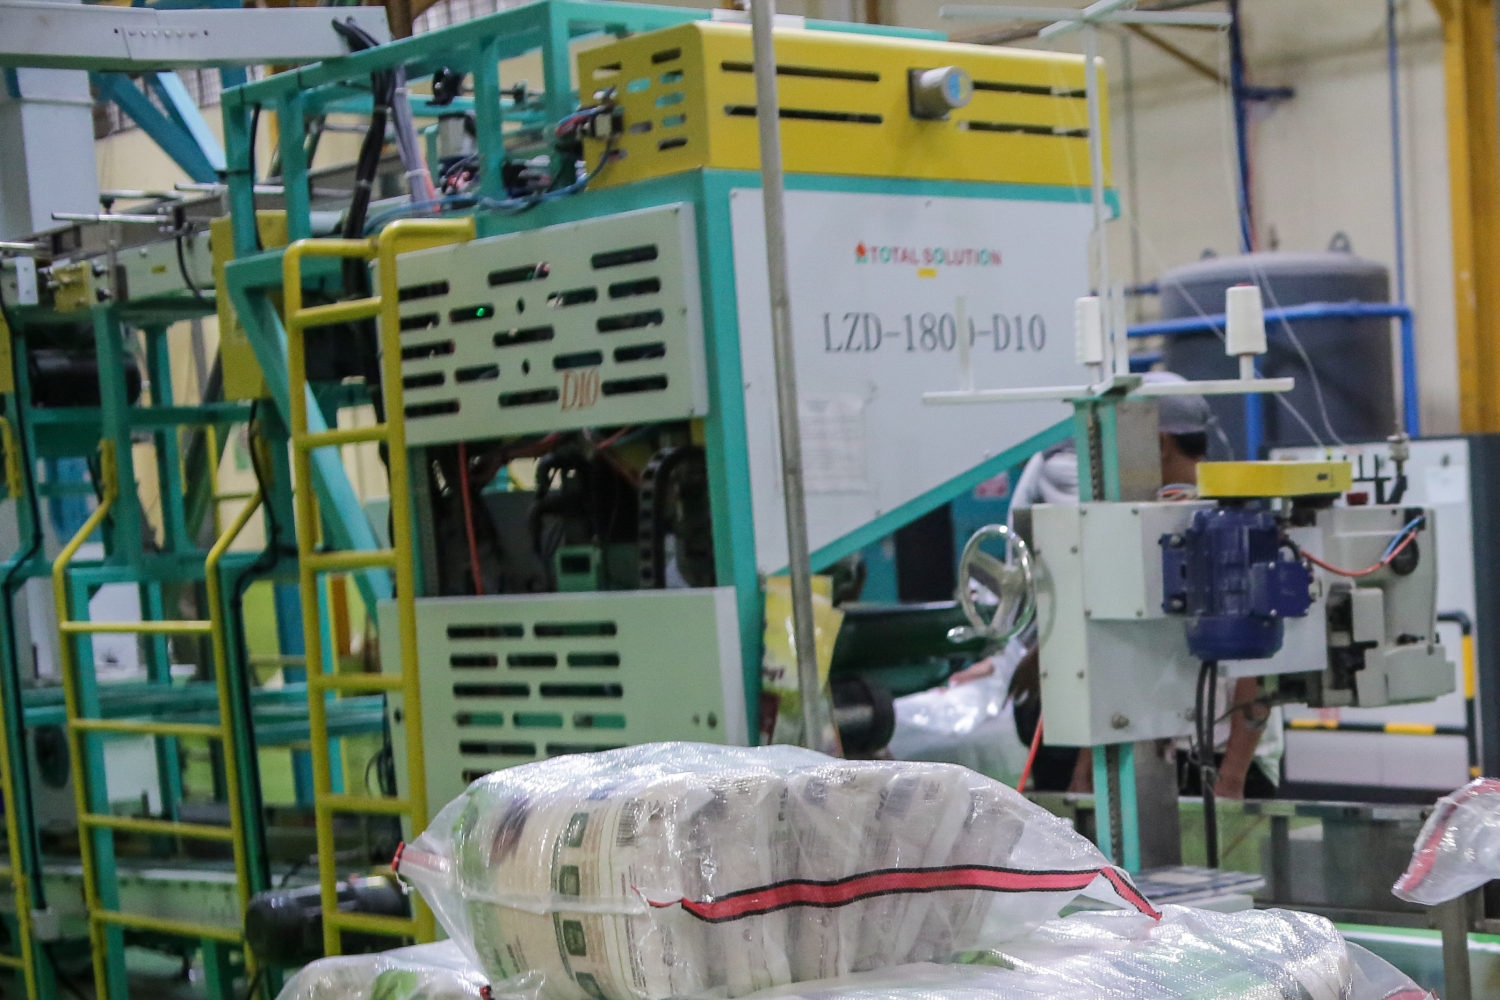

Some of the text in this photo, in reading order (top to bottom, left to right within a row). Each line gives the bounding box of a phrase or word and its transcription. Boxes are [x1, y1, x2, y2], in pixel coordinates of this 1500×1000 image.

[867, 246, 1002, 267] TOTAL SOLUTION
[823, 311, 1047, 353] LZD-180-D10
